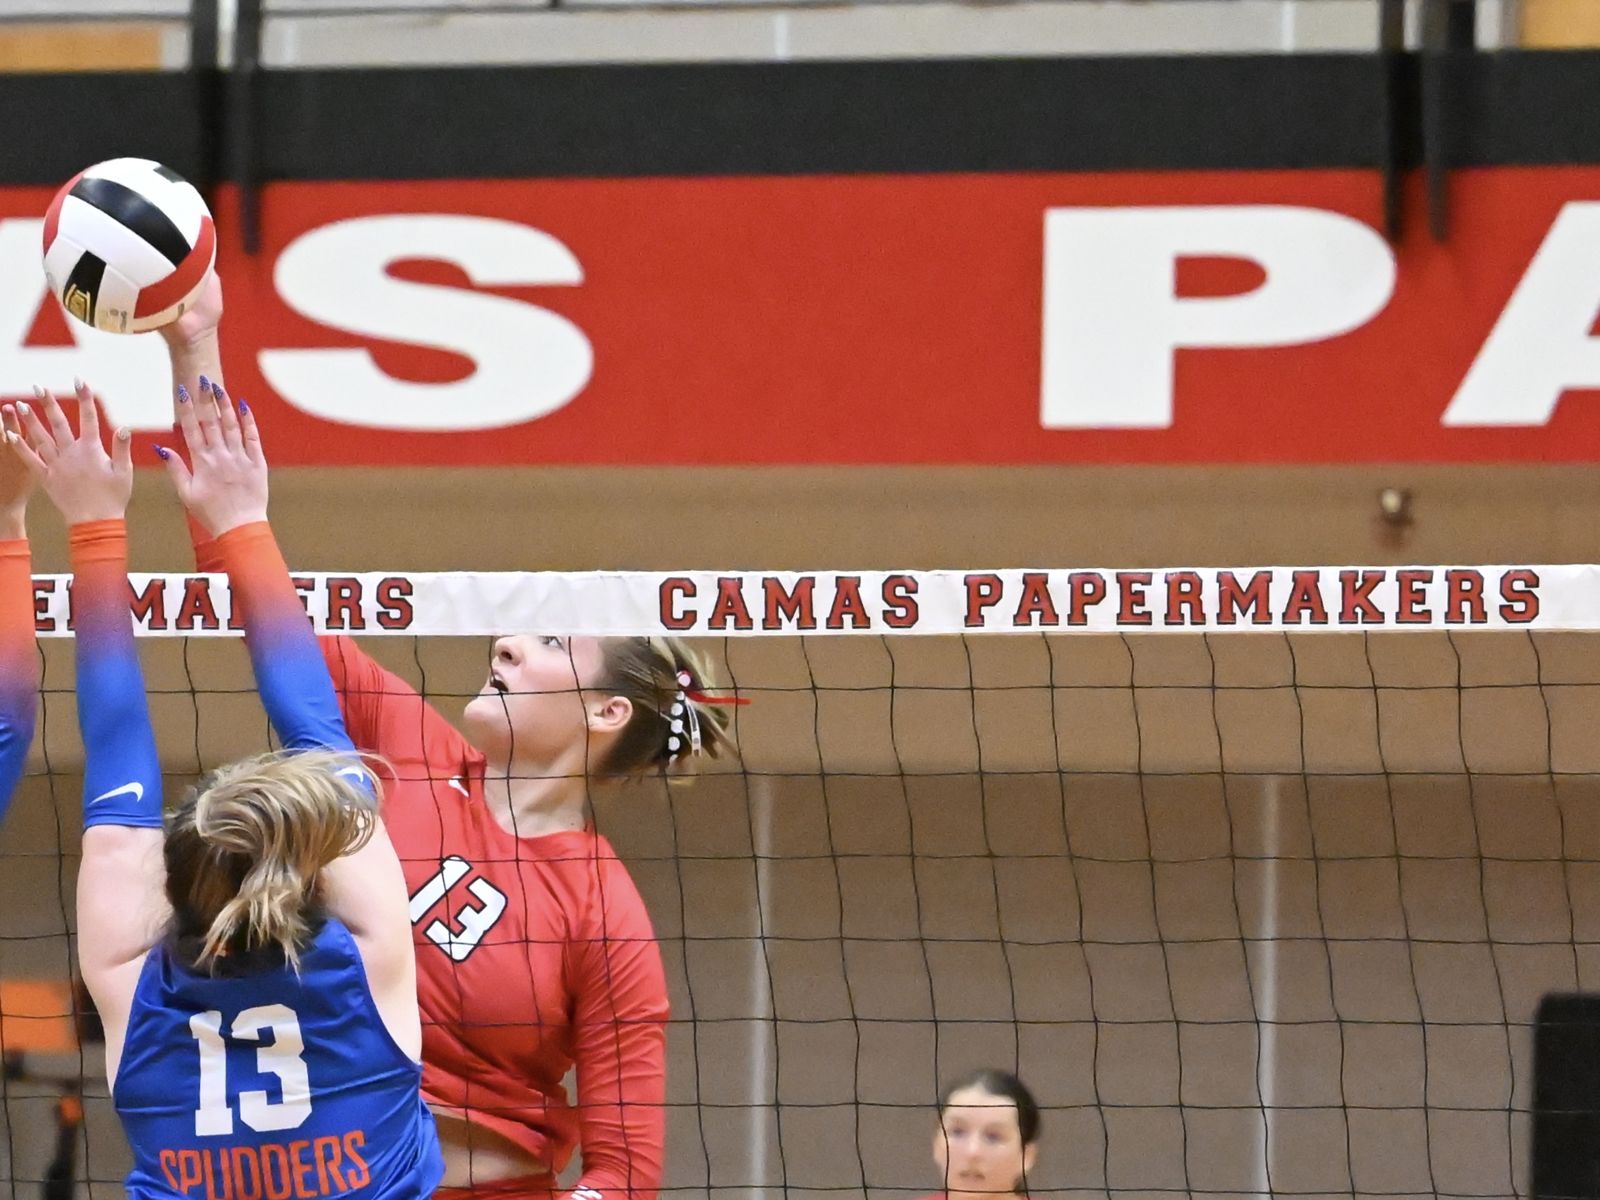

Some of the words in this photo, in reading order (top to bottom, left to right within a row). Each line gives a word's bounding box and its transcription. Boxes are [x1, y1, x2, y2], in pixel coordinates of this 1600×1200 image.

[659, 574, 919, 631] CAMAS
[963, 569, 1541, 628] PAPERMAKERS
[408, 854, 509, 963] 13
[189, 1003, 312, 1137] 13
